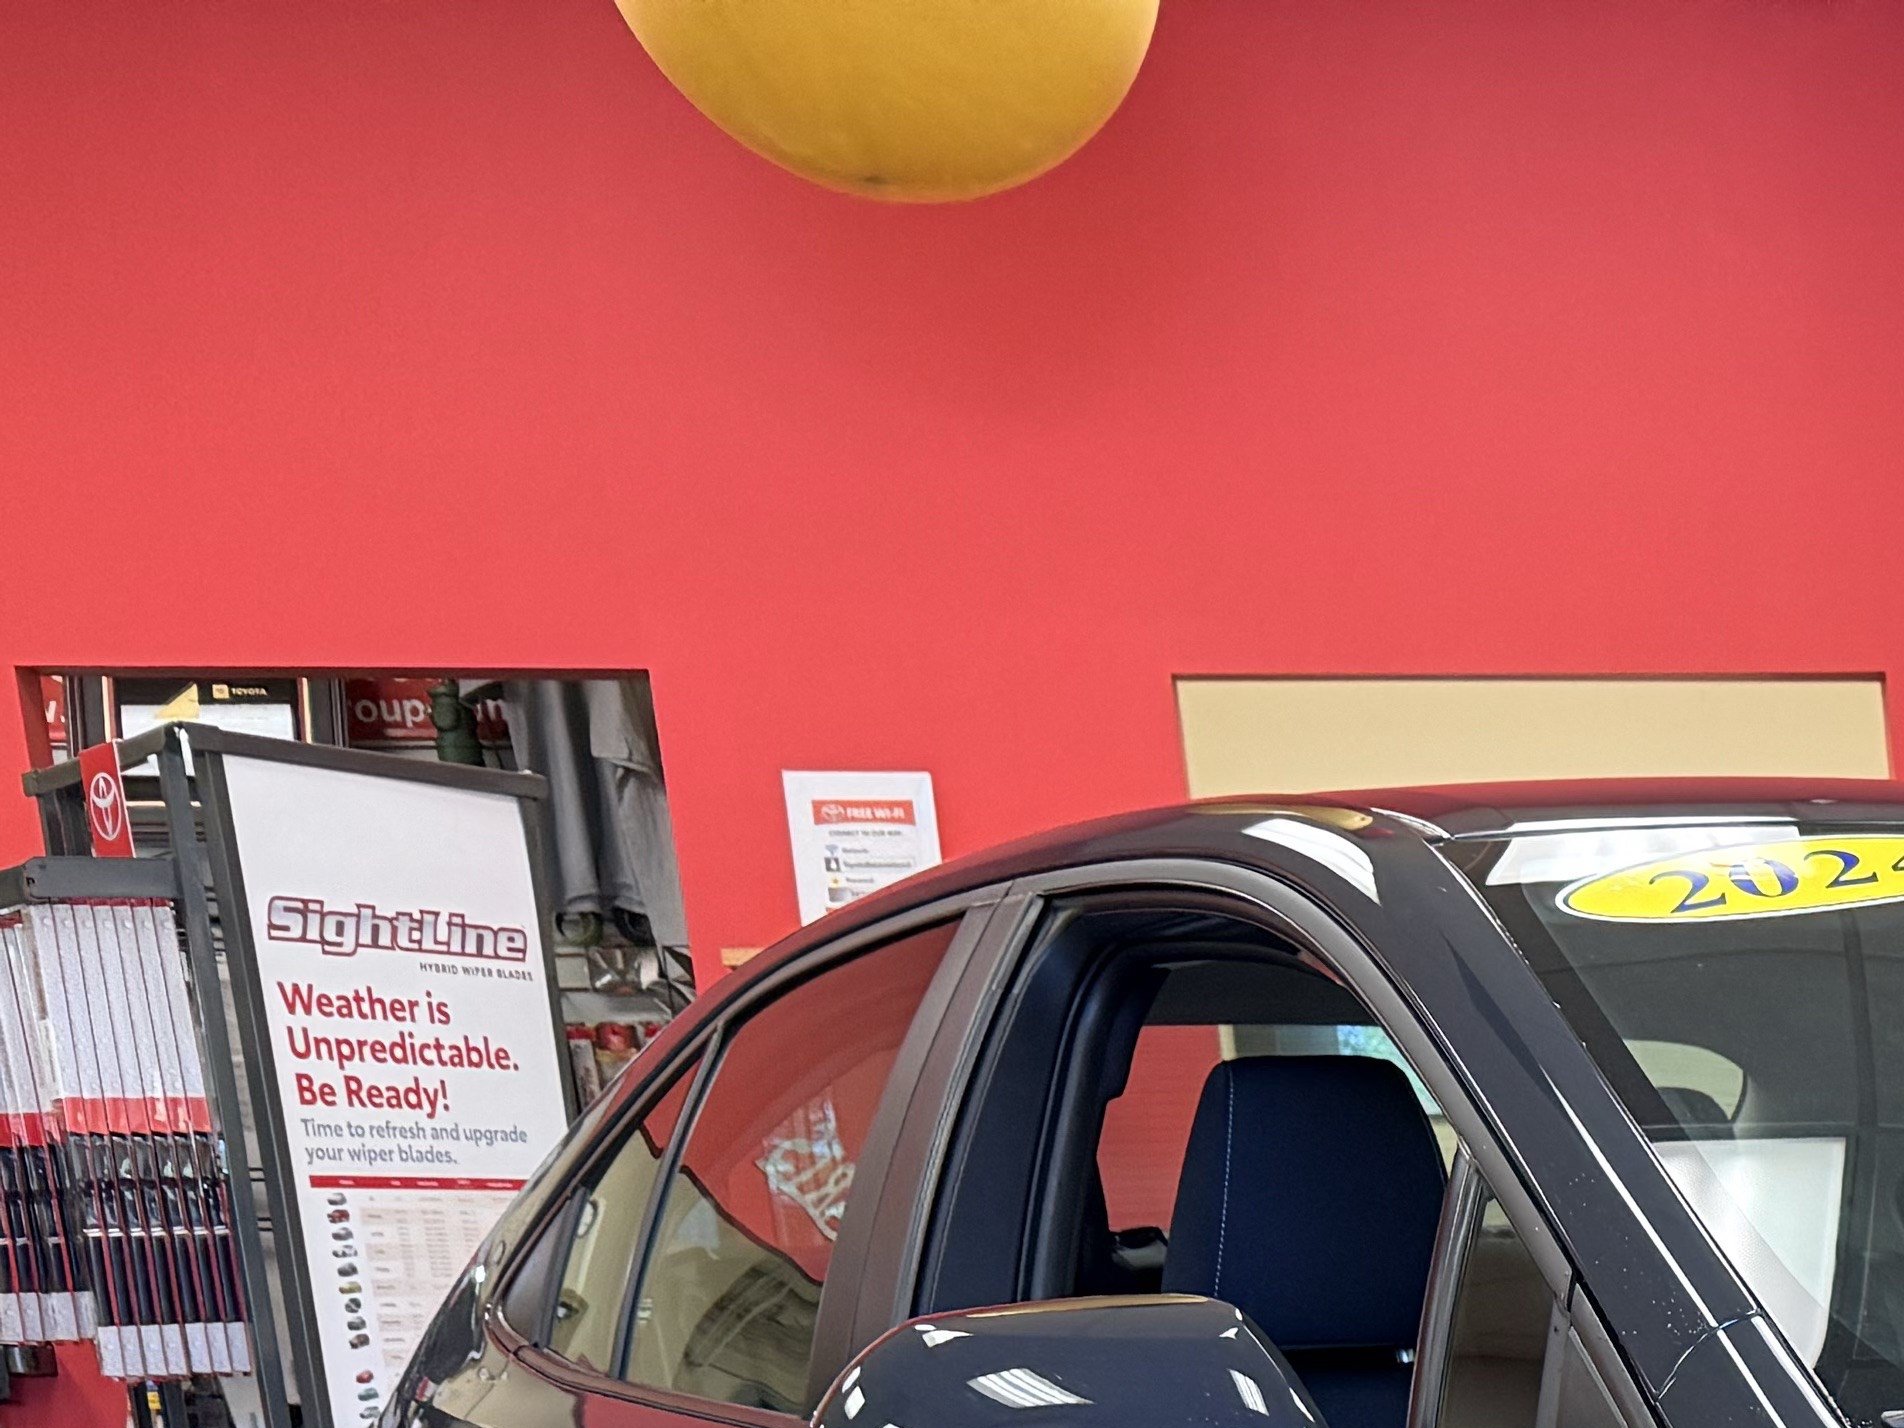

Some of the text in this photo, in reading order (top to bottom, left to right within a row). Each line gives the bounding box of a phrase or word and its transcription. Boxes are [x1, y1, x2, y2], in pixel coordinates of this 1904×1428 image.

[231, 687, 268, 696] TOYOTA
[267, 895, 527, 962] SightLine
[419, 962, 533, 981] HYBRID WIPER BLADES
[276, 981, 451, 1025] Weather is
[286, 1026, 519, 1071] Unpredictable.
[295, 1073, 450, 1119] Be Ready!
[301, 1118, 528, 1146] Time to refresh and upgrade
[305, 1145, 457, 1166] your wiper blades.
